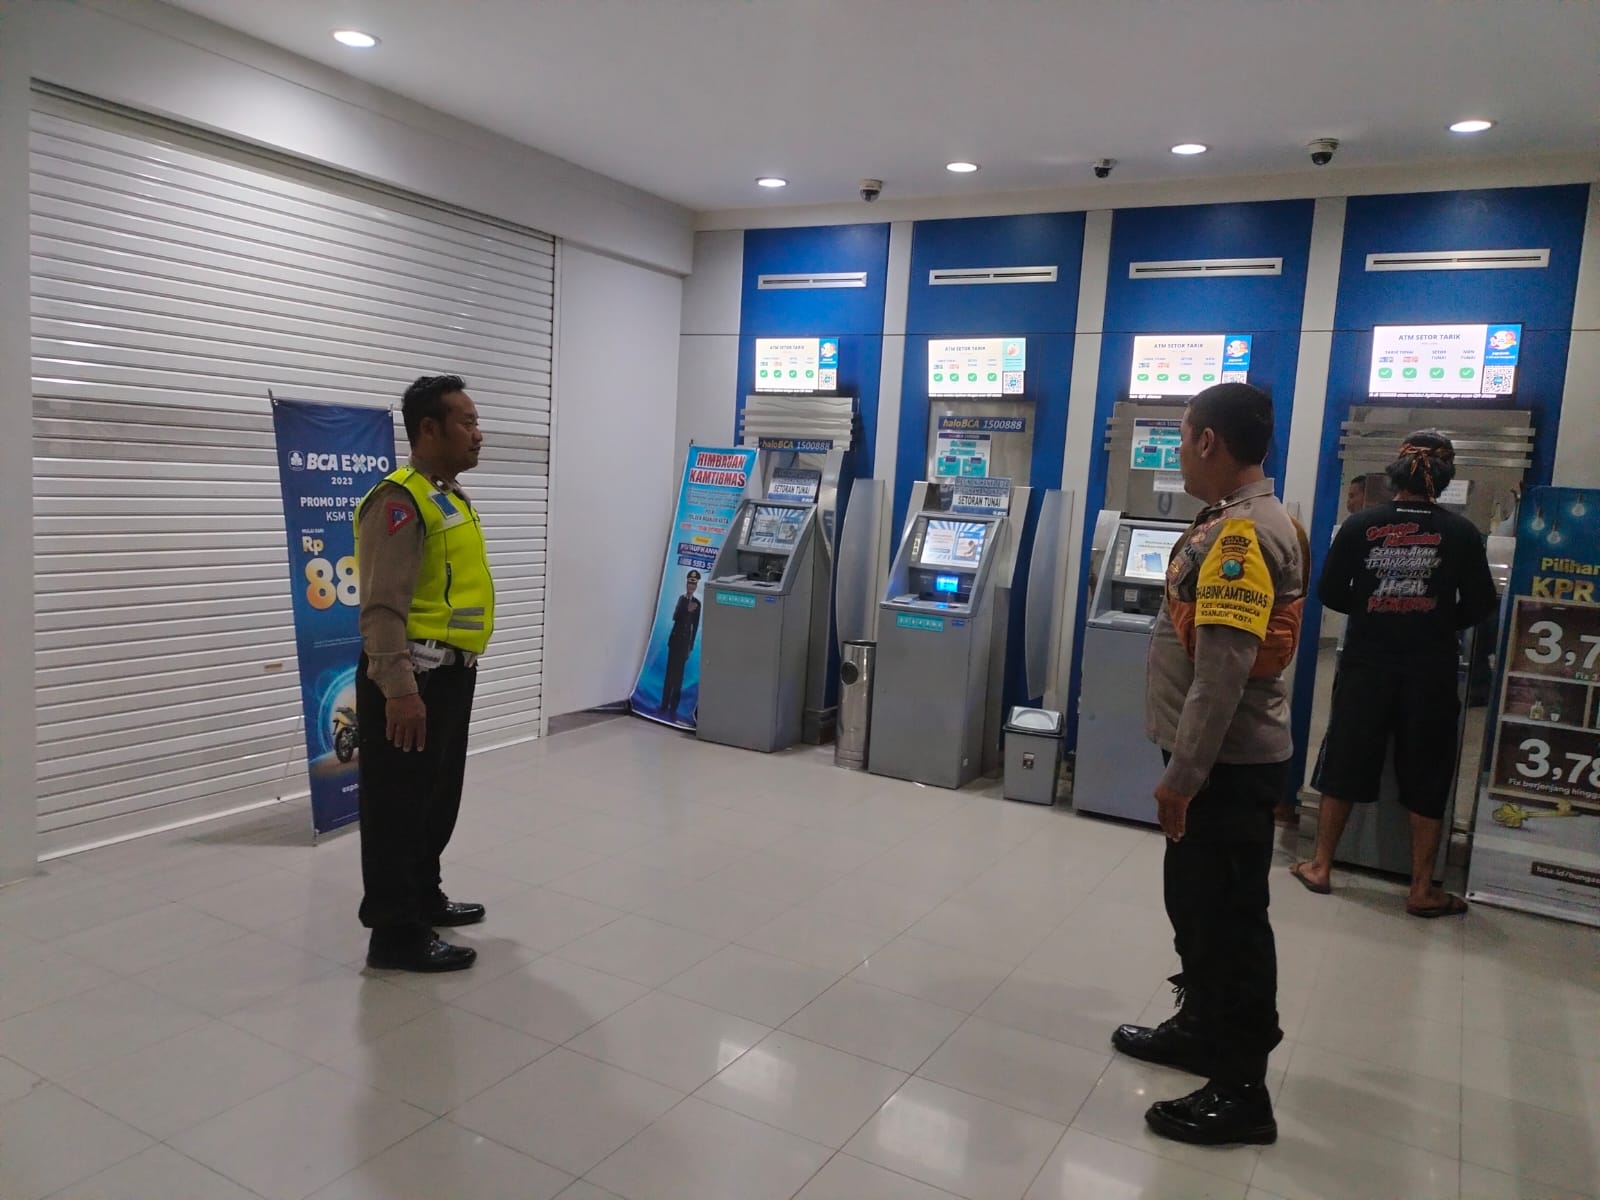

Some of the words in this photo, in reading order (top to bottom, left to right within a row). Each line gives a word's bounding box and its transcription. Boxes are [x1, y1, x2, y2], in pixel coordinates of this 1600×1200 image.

[942, 418, 980, 428] haloBCA
[983, 420, 1023, 430] 1500888
[306, 453, 338, 471] BCA
[341, 453, 390, 473] EXPO
[696, 453, 746, 469] HIMBAUAN
[330, 476, 353, 486] 2023
[689, 469, 746, 488] KAMTIBMAS
[300, 496, 334, 507] PROMO
[335, 496, 349, 507] DP
[349, 496, 363, 507] SP
[958, 495, 983, 505] SETORAN
[984, 497, 1001, 507] TUNAI
[326, 511, 347, 522] KSM
[348, 511, 354, 522] B
[302, 536, 325, 556] Rp
[1196, 584, 1268, 609] HABINKAMTIBMAS
[1531, 575, 1595, 603] KPR
[1233, 613, 1252, 624] KOTA
[1524, 620, 1600, 670] 3,7
[1508, 778, 1522, 786] Fix
[1522, 780, 1570, 795] berjenjang
